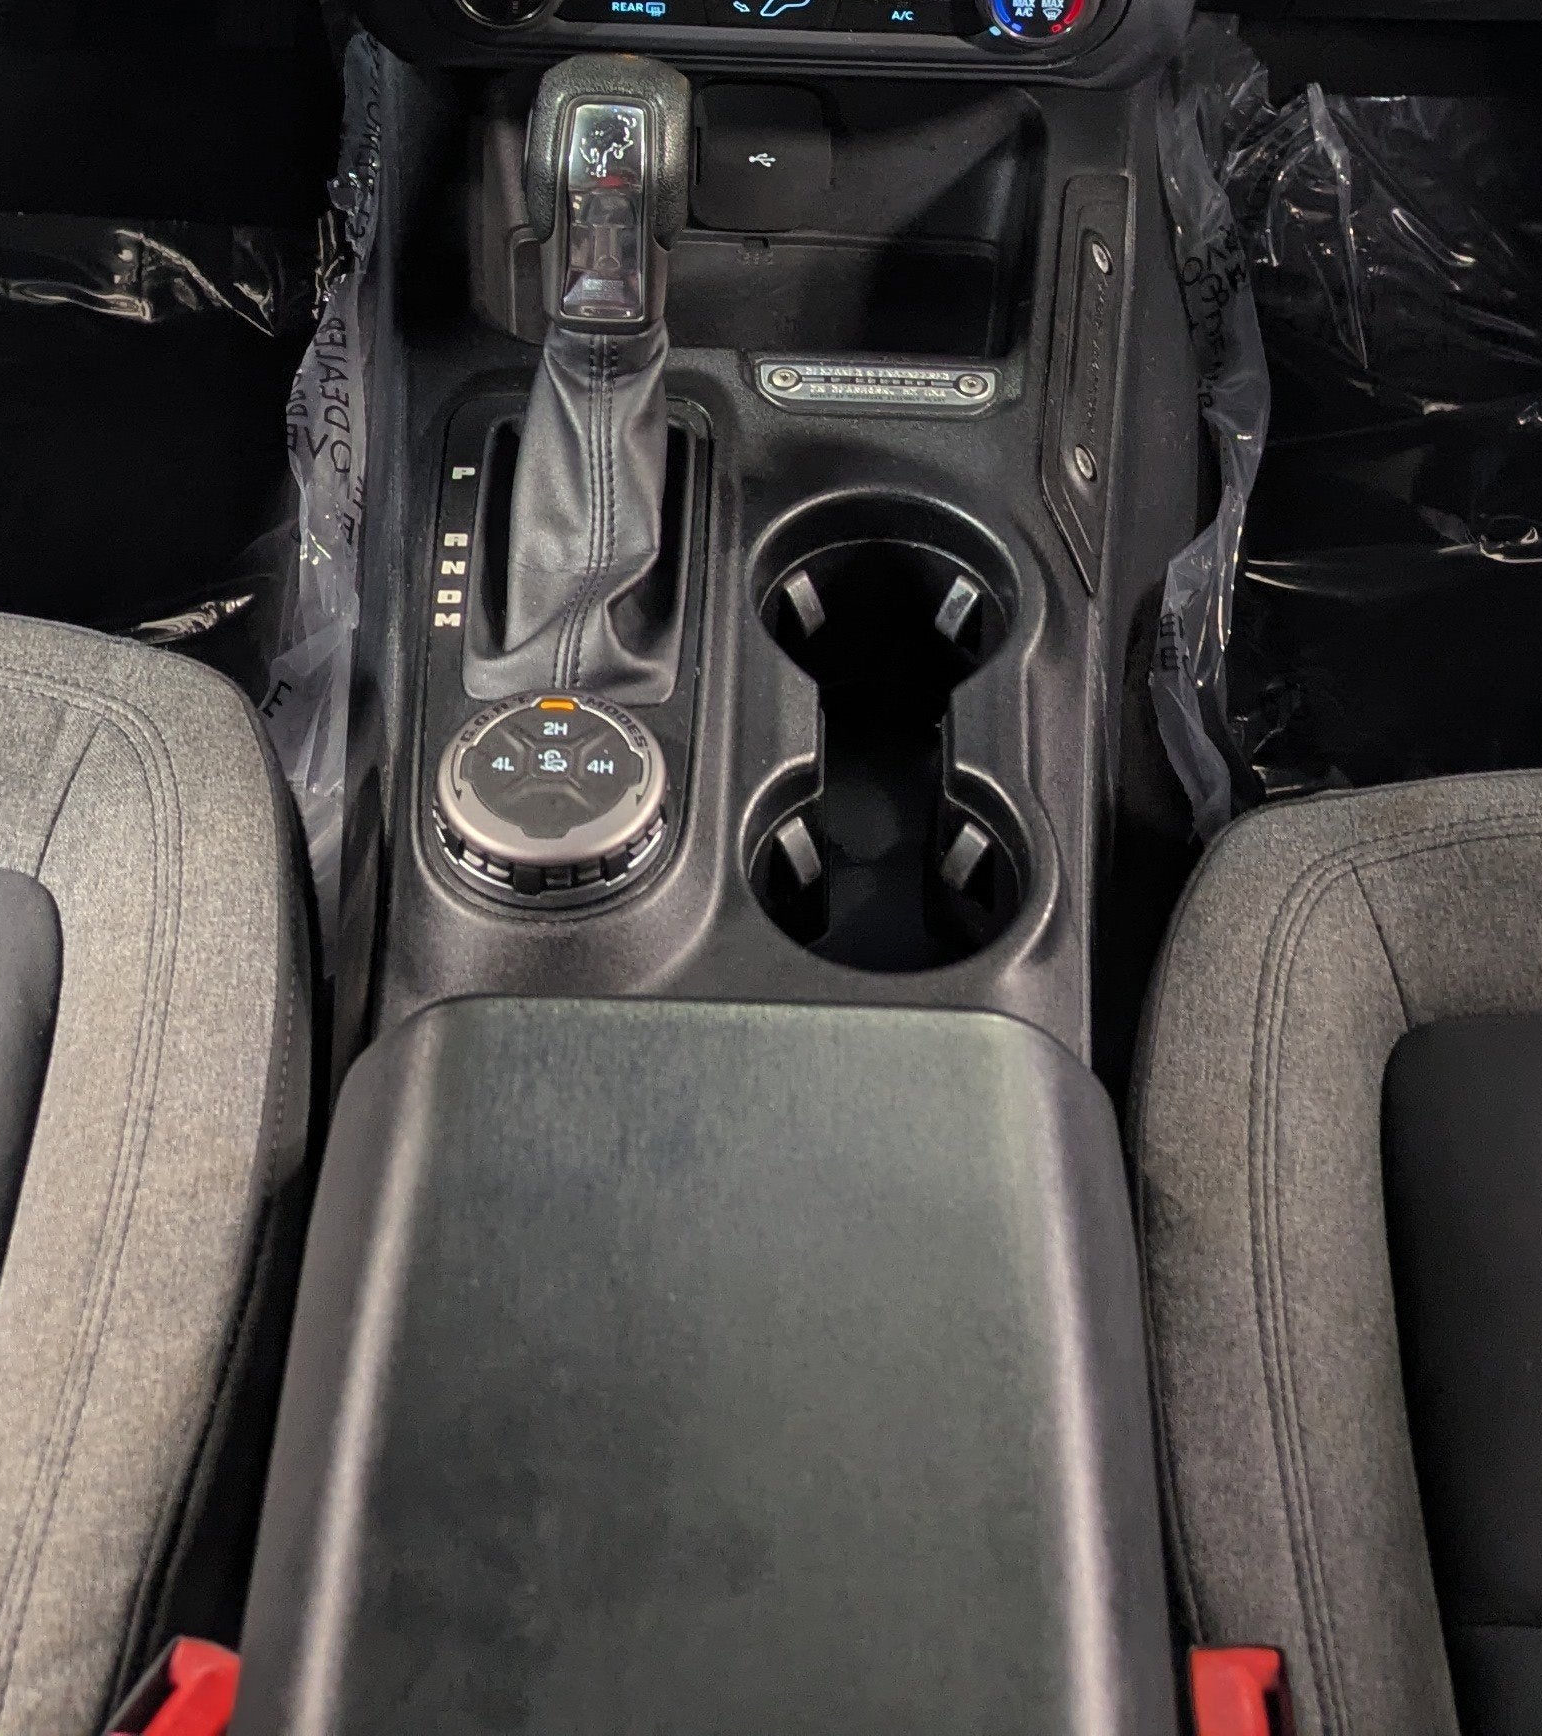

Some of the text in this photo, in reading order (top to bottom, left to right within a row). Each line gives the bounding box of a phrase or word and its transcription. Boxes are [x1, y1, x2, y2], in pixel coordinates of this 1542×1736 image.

[611, 0, 644, 13] REAR
[1015, 6, 1034, 18] A/C
[891, 10, 916, 22] A/C
[451, 466, 476, 480] P
[440, 560, 466, 575] N
[434, 612, 461, 627] M
[542, 721, 569, 737] 2H
[491, 756, 515, 772] 4L
[586, 759, 615, 775] 4H
